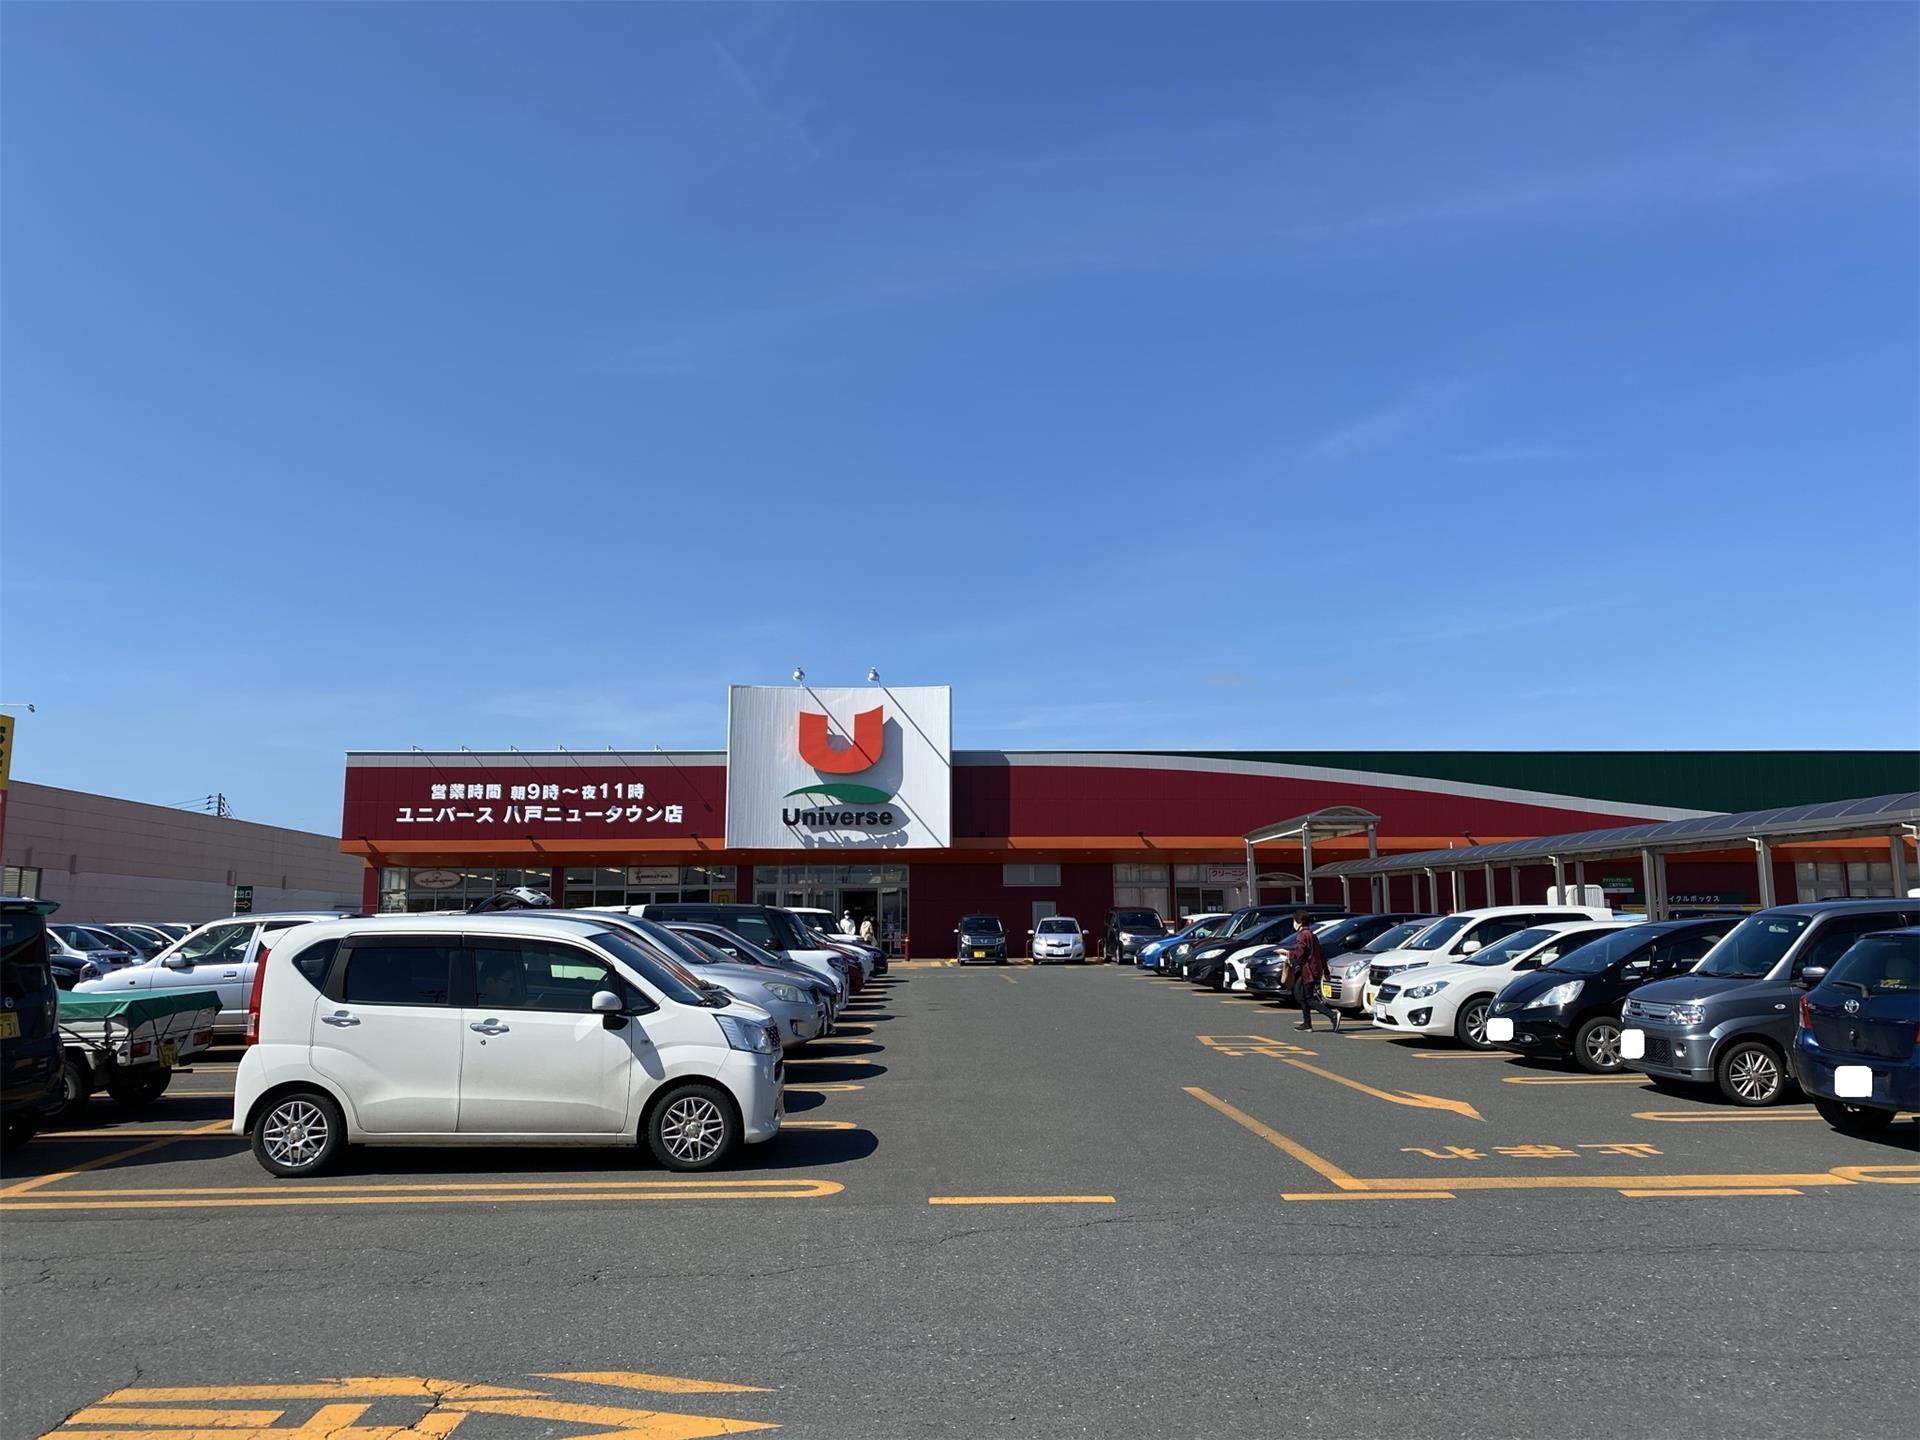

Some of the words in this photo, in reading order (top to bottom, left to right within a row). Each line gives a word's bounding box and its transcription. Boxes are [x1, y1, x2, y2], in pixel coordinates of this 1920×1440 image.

[430, 783, 502, 800] 営業時間
[396, 805, 494, 824] ユニバース
[503, 805, 684, 824] 八戸ニュータウン店
[782, 807, 893, 827] Universe
[1212, 870, 1248, 878] クリーニン
[1658, 894, 1720, 903] イクルボックス
